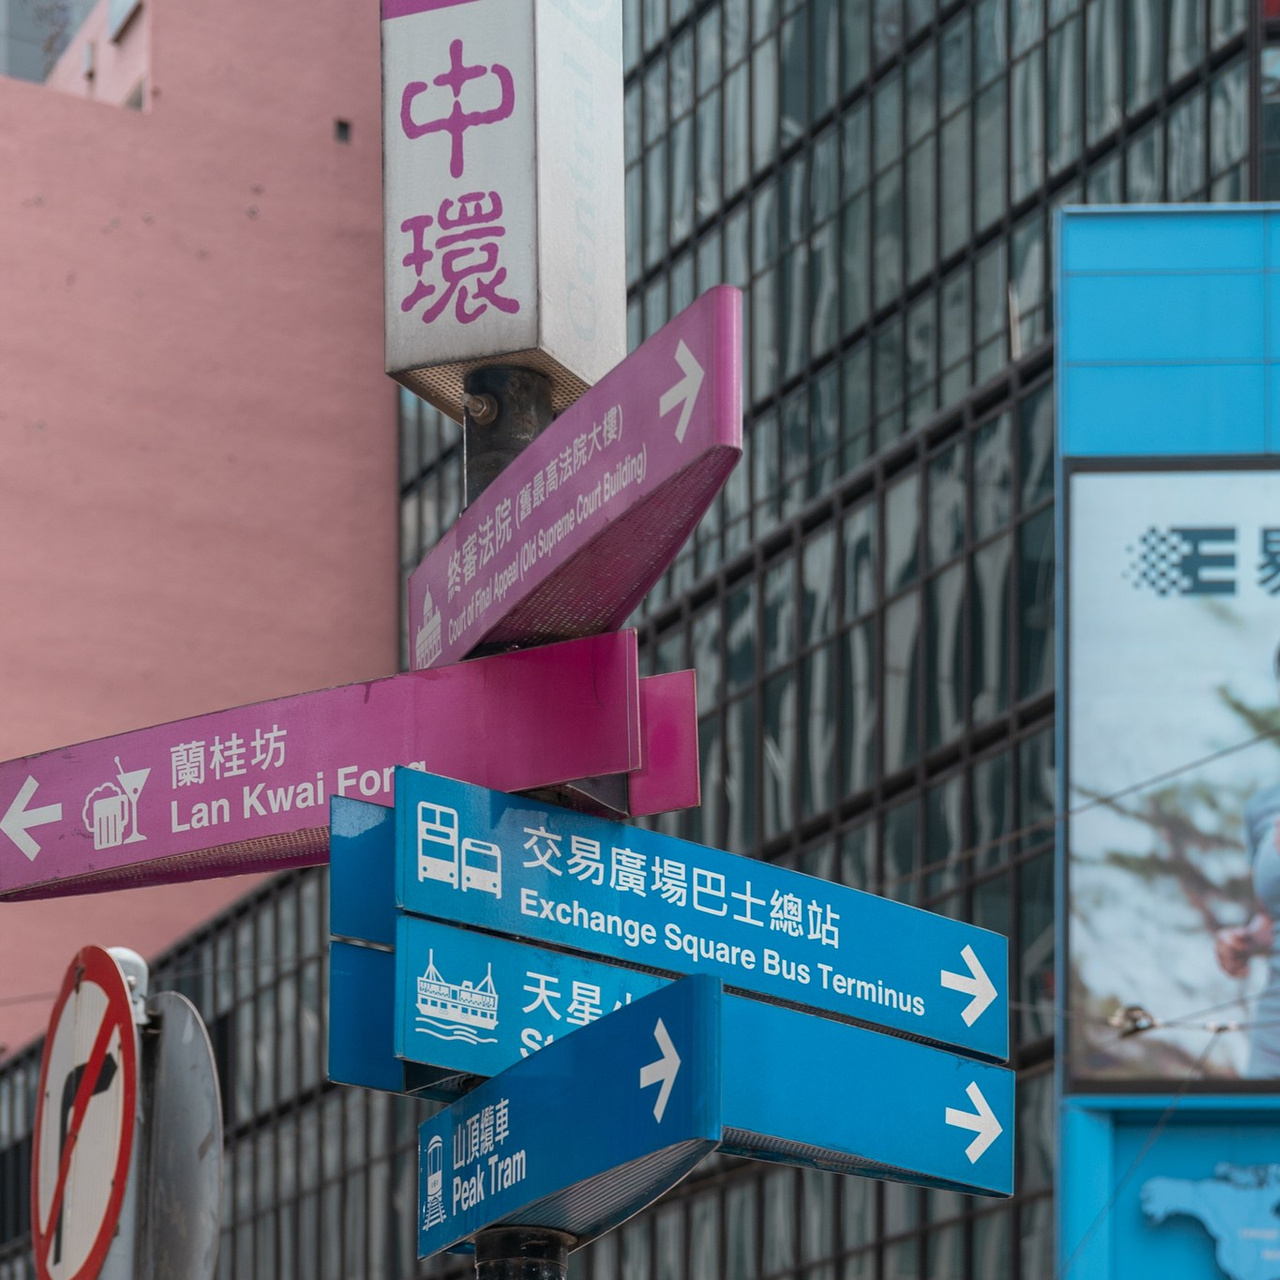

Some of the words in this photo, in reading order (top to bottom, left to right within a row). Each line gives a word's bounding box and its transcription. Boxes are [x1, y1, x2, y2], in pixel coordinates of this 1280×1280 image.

[400, 38, 520, 325] 中環
[447, 497, 512, 604] 終審法院
[448, 606, 467, 646] Court
[467, 593, 475, 627] of
[475, 577, 492, 621] Final
[494, 553, 519, 604] Appeal
[520, 534, 537, 582] (Old
[538, 508, 575, 558] Supreme
[576, 480, 602, 525] Court
[603, 443, 647, 503] Building)
[170, 724, 288, 790] 蘭桂坊
[170, 797, 231, 834] Lan
[242, 770, 325, 819] Kwai
[522, 825, 841, 950] 交易廣場巴士總站
[520, 887, 657, 948] Exchange
[664, 922, 756, 970] Square
[763, 948, 811, 985] Bus
[817, 962, 926, 1017] Terminus
[452, 1097, 510, 1171] 山頂纜車
[452, 1164, 485, 1217] Peak
[487, 1149, 527, 1196] Tram
